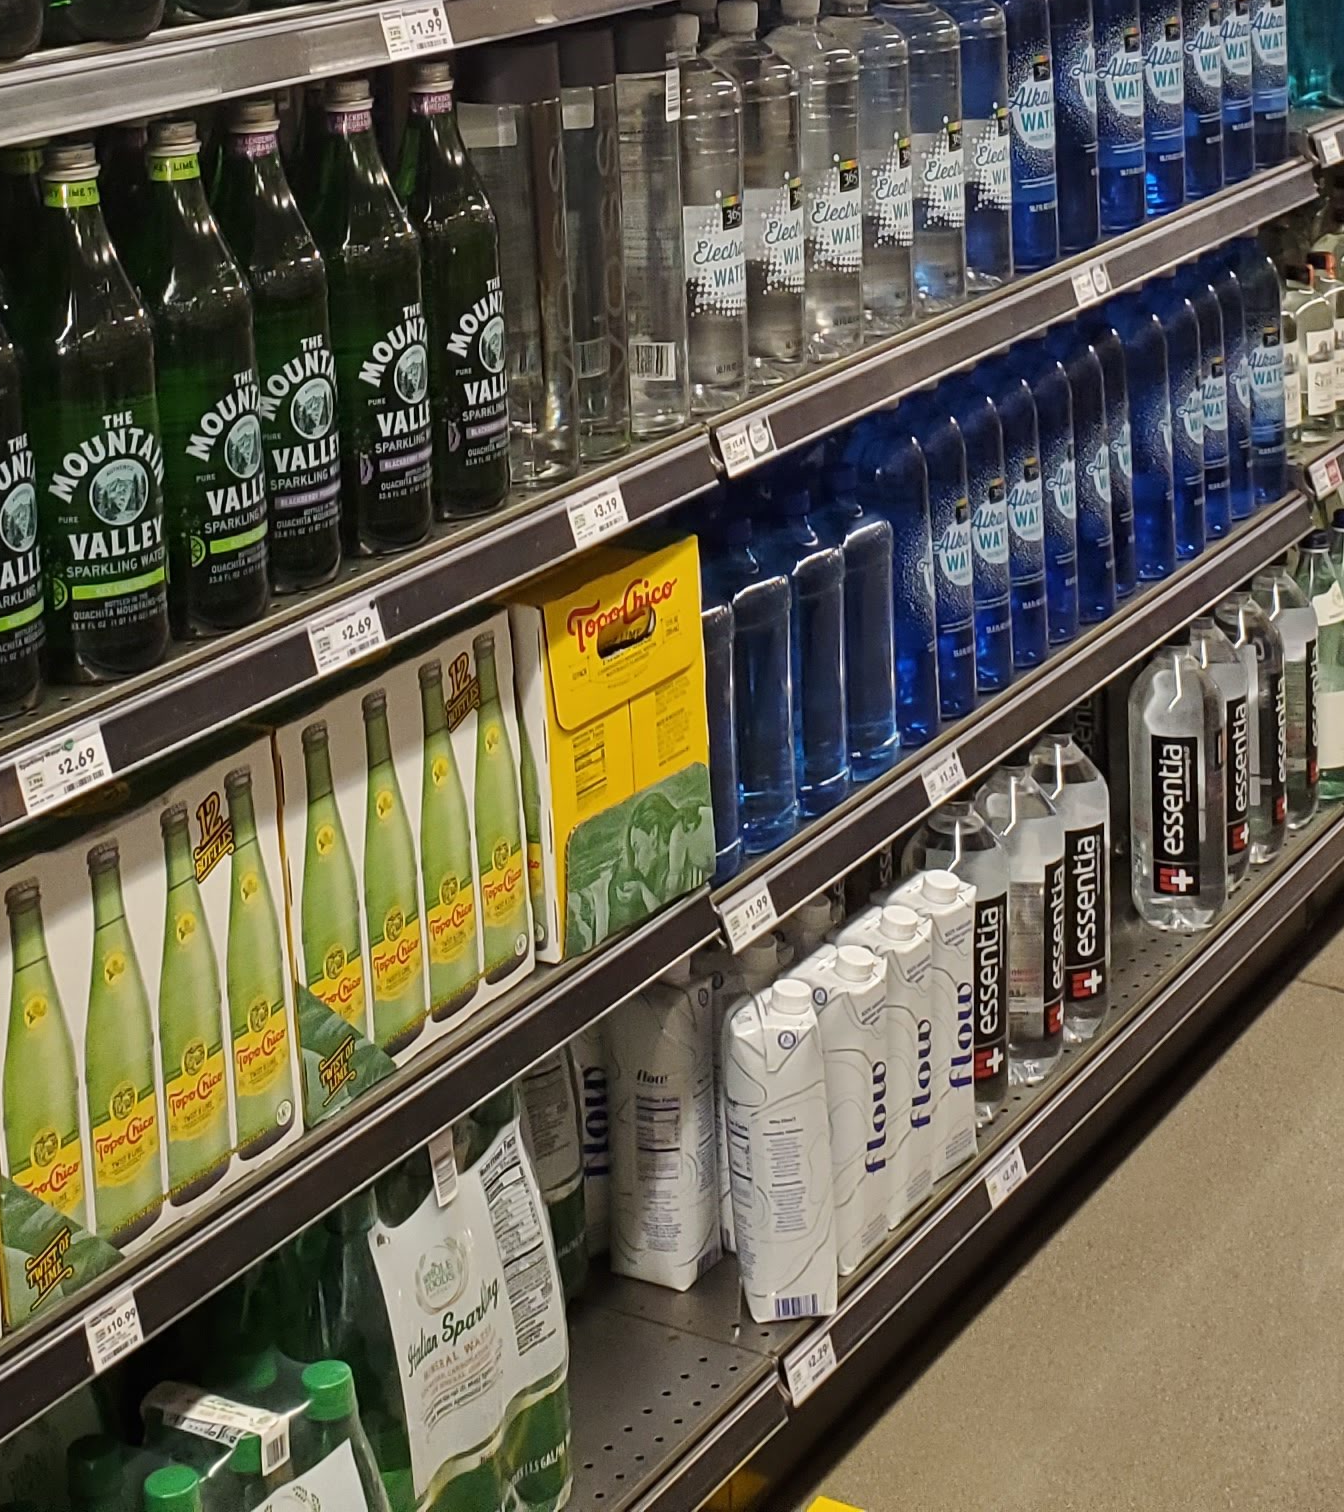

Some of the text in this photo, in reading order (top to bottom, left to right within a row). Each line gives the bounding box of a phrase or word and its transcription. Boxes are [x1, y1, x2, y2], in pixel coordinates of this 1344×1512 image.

[102, 410, 133, 429] THE
[48, 427, 165, 504] MOUNTAIN
[58, 516, 78, 524] PURE
[594, 497, 617, 518] $3.19
[68, 514, 163, 561] VALLEY
[342, 617, 372, 641] $2.69
[448, 652, 470, 692] 12
[58, 749, 95, 775] $2.69
[197, 794, 222, 843] 12
[1163, 742, 1184, 857] essentia
[196, 830, 233, 875] BOTTLES
[745, 895, 767, 919] $1.99
[1077, 832, 1098, 961] essentia
[975, 904, 1000, 1036] essentia
[949, 981, 974, 1089] flow
[912, 1020, 932, 1130] flow
[867, 1061, 887, 1174] flow
[106, 1308, 137, 1334] $10.99
[406, 1277, 499, 1377] Italian Sparkling
[808, 1345, 828, 1367] $2.29
